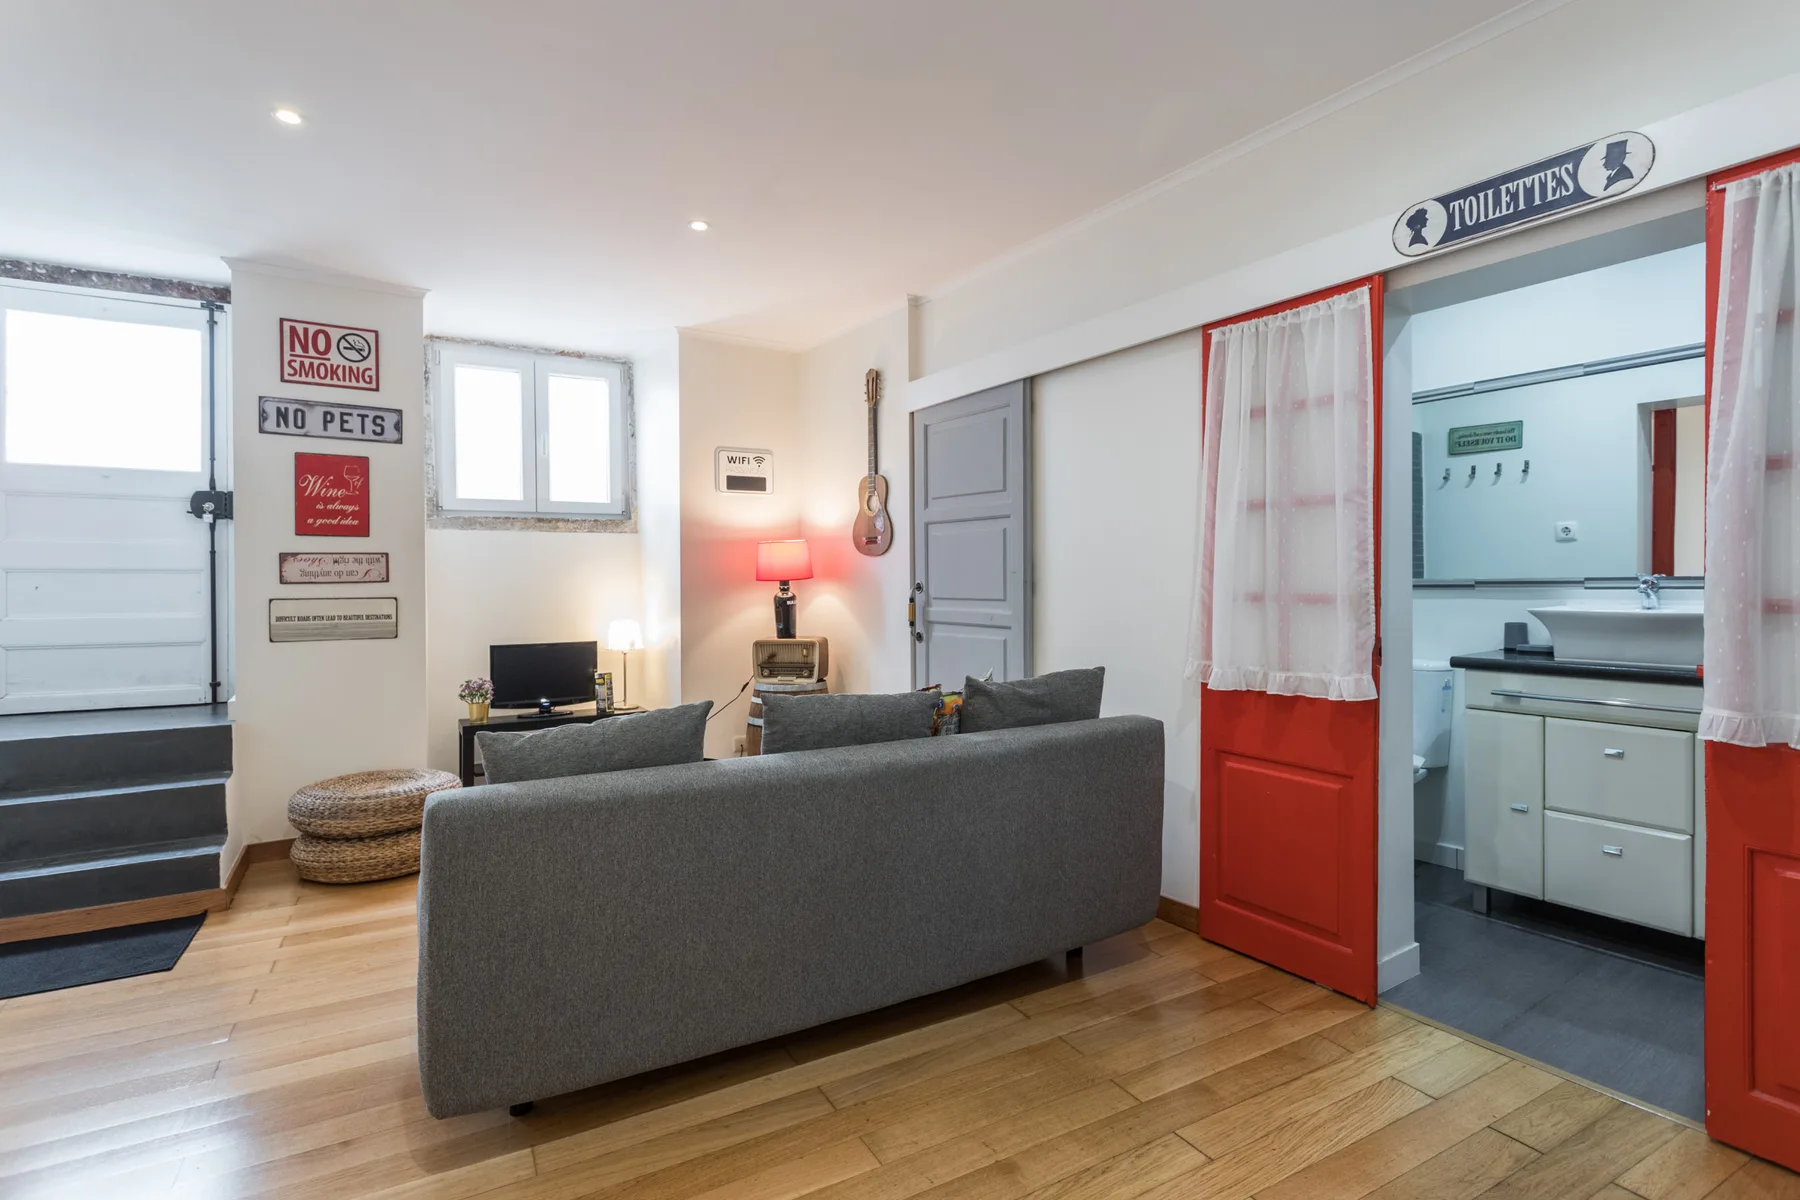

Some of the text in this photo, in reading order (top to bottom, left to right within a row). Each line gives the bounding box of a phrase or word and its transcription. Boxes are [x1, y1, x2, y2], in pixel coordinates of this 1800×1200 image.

[1449, 162, 1575, 232] TOILETTES
[289, 325, 332, 357] NO
[287, 359, 373, 385] SMOKING
[276, 406, 306, 430] NO
[322, 410, 386, 437] PETS
[726, 455, 750, 465] WIFI
[299, 474, 346, 498] Wine
[316, 500, 359, 514] is always
[314, 516, 341, 528] good
[340, 516, 359, 525] idea
[332, 556, 350, 567] right
[352, 557, 363, 566] the
[365, 557, 381, 566] with
[300, 568, 333, 580] anything
[333, 570, 344, 579] do
